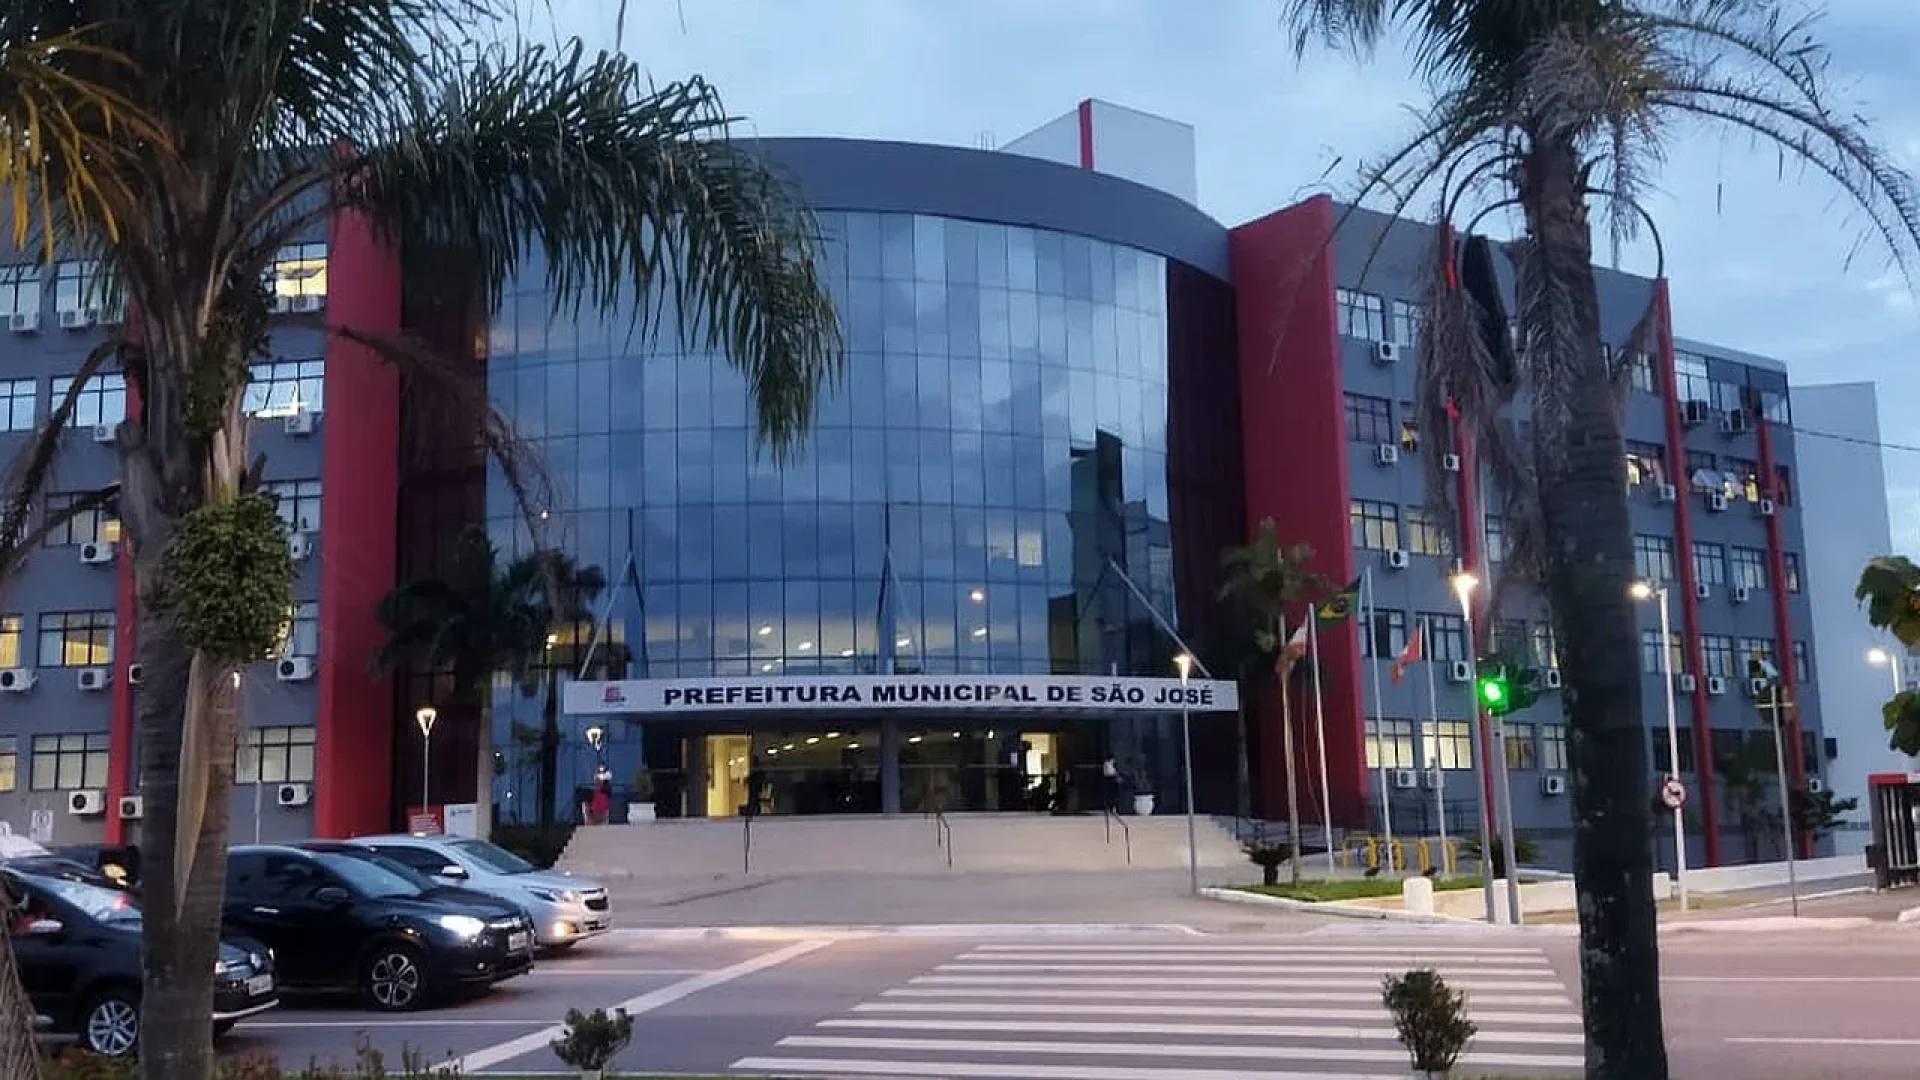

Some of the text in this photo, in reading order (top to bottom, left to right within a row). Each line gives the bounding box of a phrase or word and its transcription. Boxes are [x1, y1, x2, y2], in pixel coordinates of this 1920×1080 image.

[664, 683, 1213, 705] PREFEITURA MUNICIPAL DE SÃO JOSÉ
